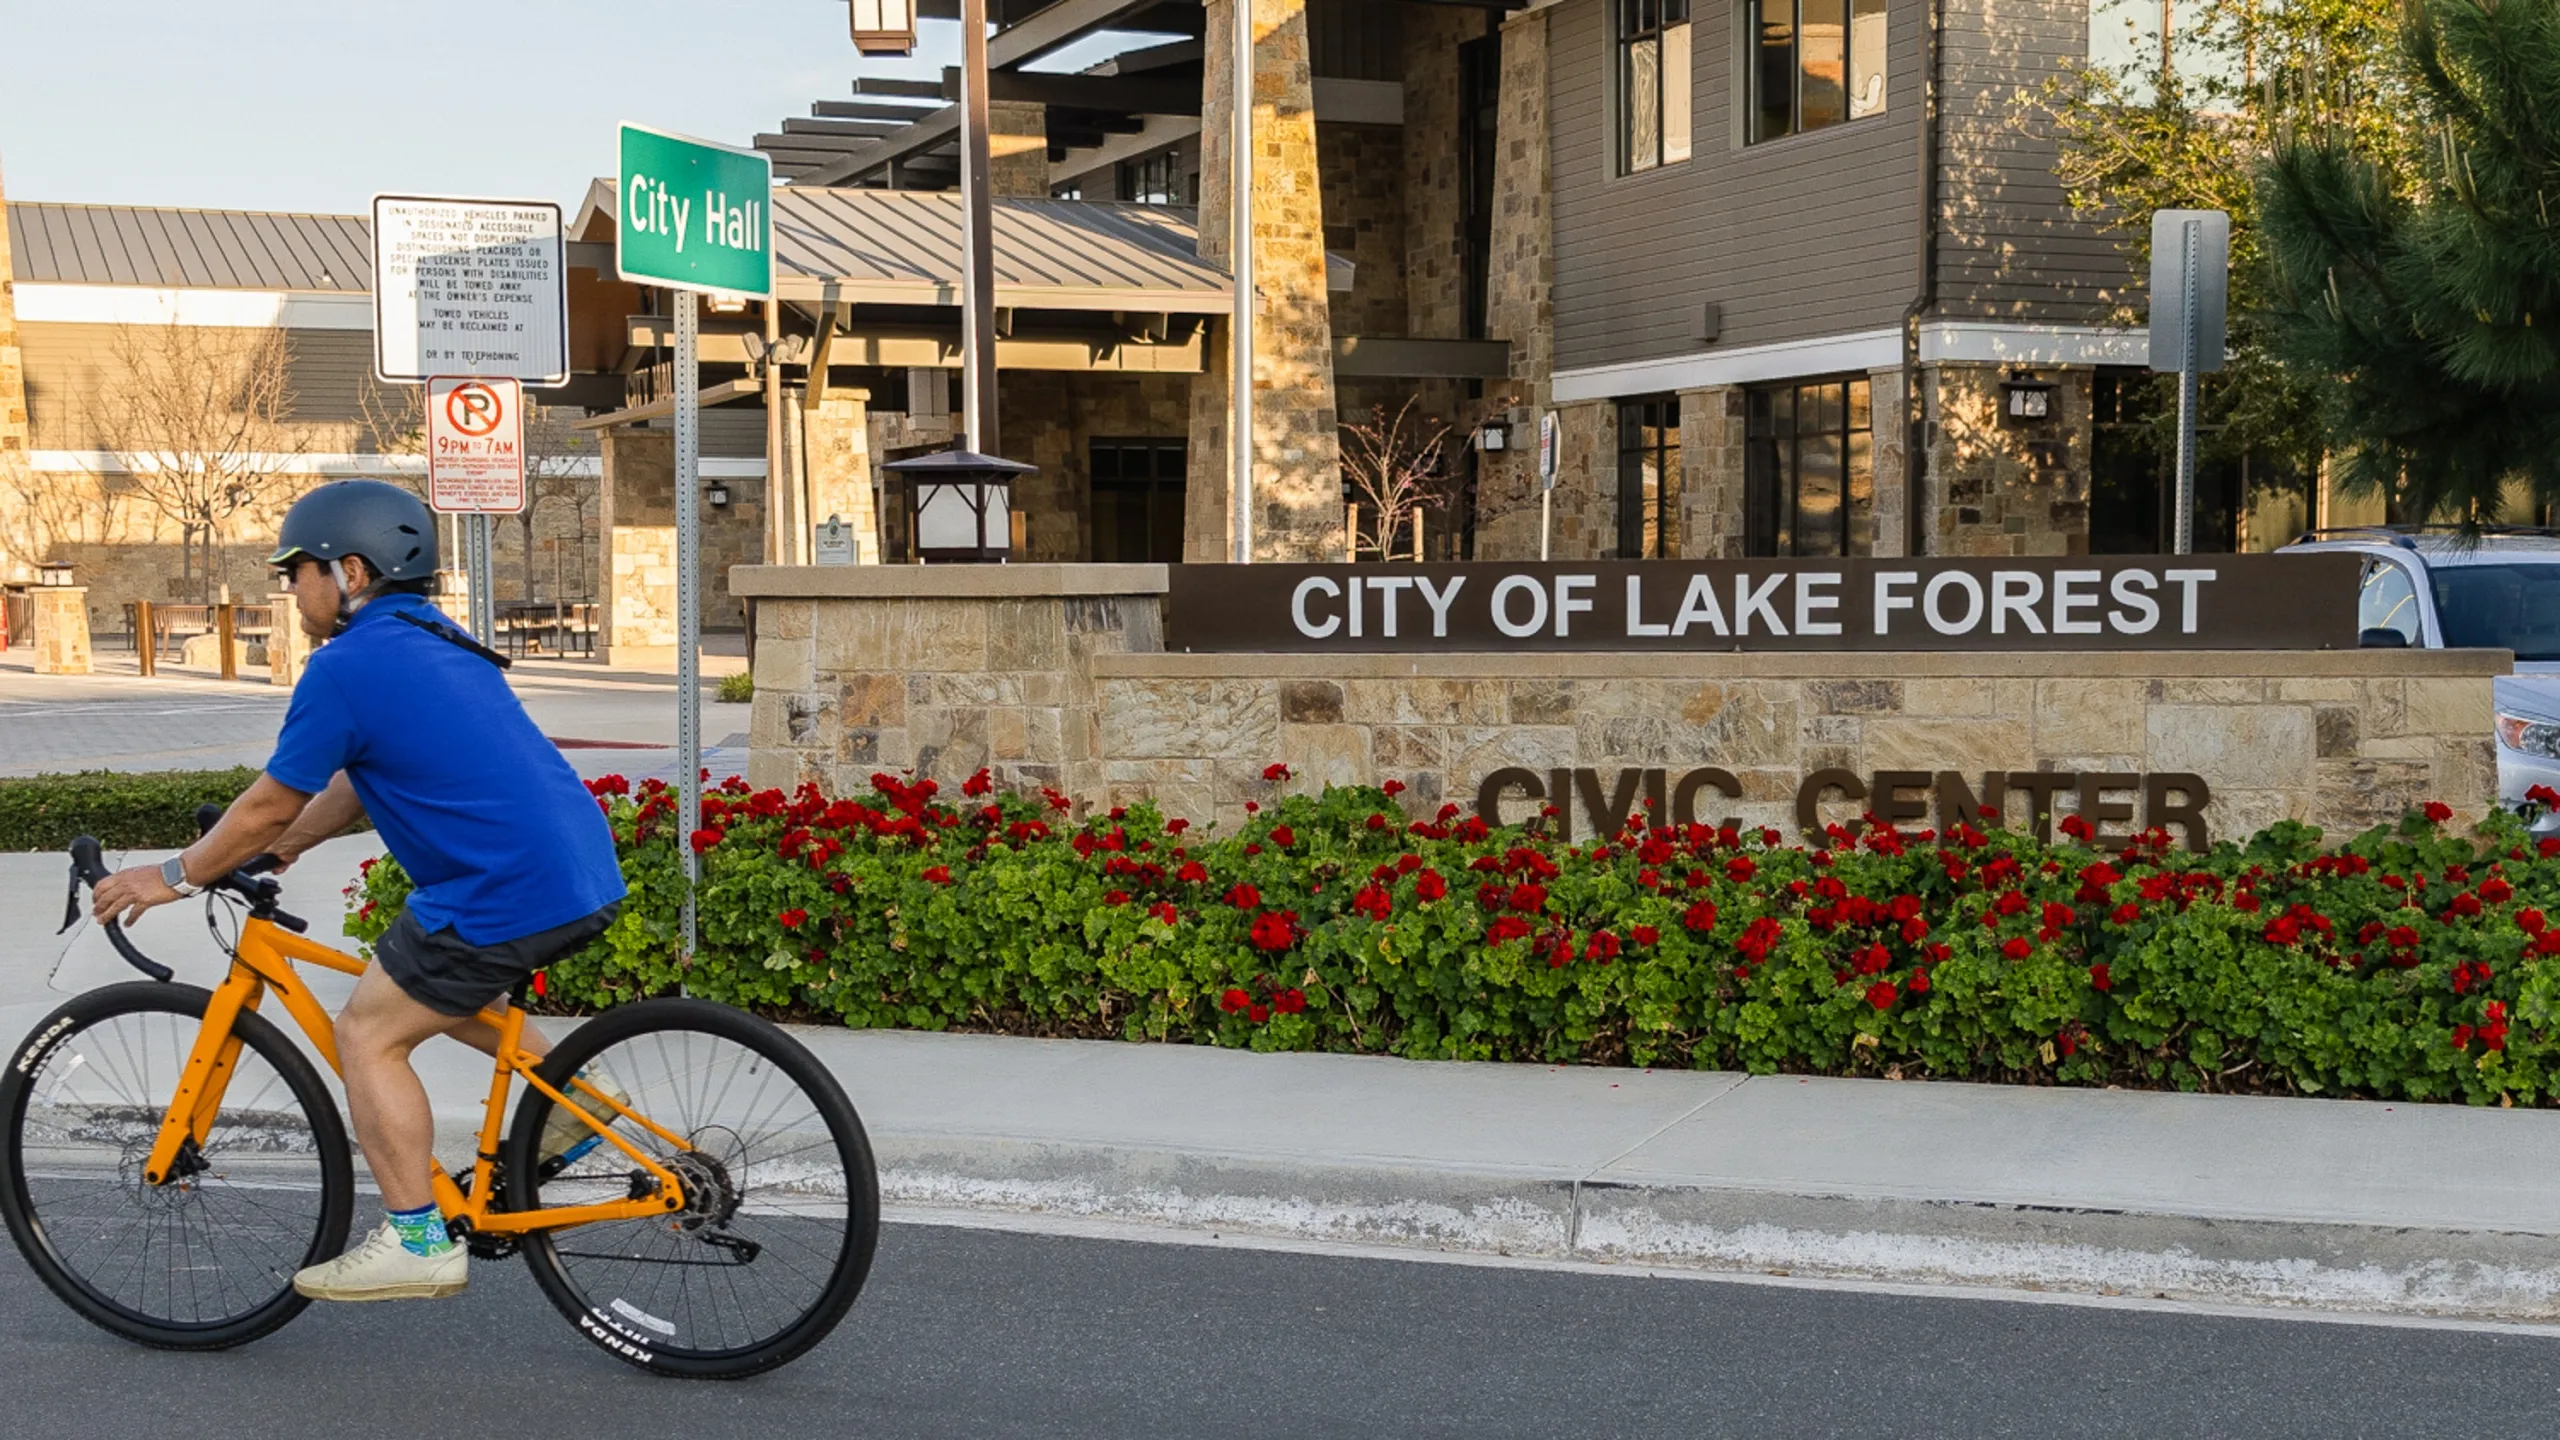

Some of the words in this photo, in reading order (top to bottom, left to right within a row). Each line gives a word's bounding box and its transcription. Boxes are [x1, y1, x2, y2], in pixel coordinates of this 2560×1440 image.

[464, 210, 507, 220] VEHICLES
[513, 211, 548, 222] PARKED
[629, 173, 690, 253] City
[706, 190, 761, 252] Hall
[419, 220, 474, 231] DESIGNATED
[479, 223, 533, 233] ACCESSIBLE
[411, 231, 444, 241] SPACES
[451, 233, 468, 242] NOT
[474, 235, 528, 245] DISPLAYING
[476, 246, 523, 256] PLACARDS
[529, 248, 541, 256] OR
[390, 254, 427, 264] SPECIAL
[434, 256, 472, 266] LICENSE
[478, 258, 510, 268] PLATES
[516, 259, 548, 268] ISSUED
[416, 267, 456, 277] PERSONS
[463, 269, 483, 278] WITH
[490, 270, 549, 280] DISABILITIES
[419, 280, 440, 289] WILL
[447, 281, 458, 289] BE
[464, 281, 493, 290] TOWED
[500, 282, 521, 291] AWAY
[424, 291, 440, 300] THE
[447, 292, 487, 302] OWNER'S
[494, 293, 533, 303] EXPENSE
[434, 309, 461, 318] TOWED
[468, 310, 509, 320] VEHICLES
[419, 321, 435, 329] MAY
[442, 321, 453, 330] BE
[460, 322, 508, 332] RECLAIMED
[514, 323, 524, 332] AT
[426, 349, 438, 359] OR
[444, 350, 455, 359] BY
[461, 350, 519, 361] TELEPHONING
[438, 436, 469, 454] 9PM
[485, 437, 513, 454] 7AM
[1292, 576, 1466, 638] CITY
[1491, 575, 1596, 636] OF
[1627, 573, 1842, 635] LAKE
[1875, 569, 2216, 635] FOREST
[1478, 767, 1743, 845] CIVIC
[1796, 768, 2210, 853] CENTER
[16, 1016, 75, 1072] KENDA
[580, 1314, 653, 1362] KENDA
